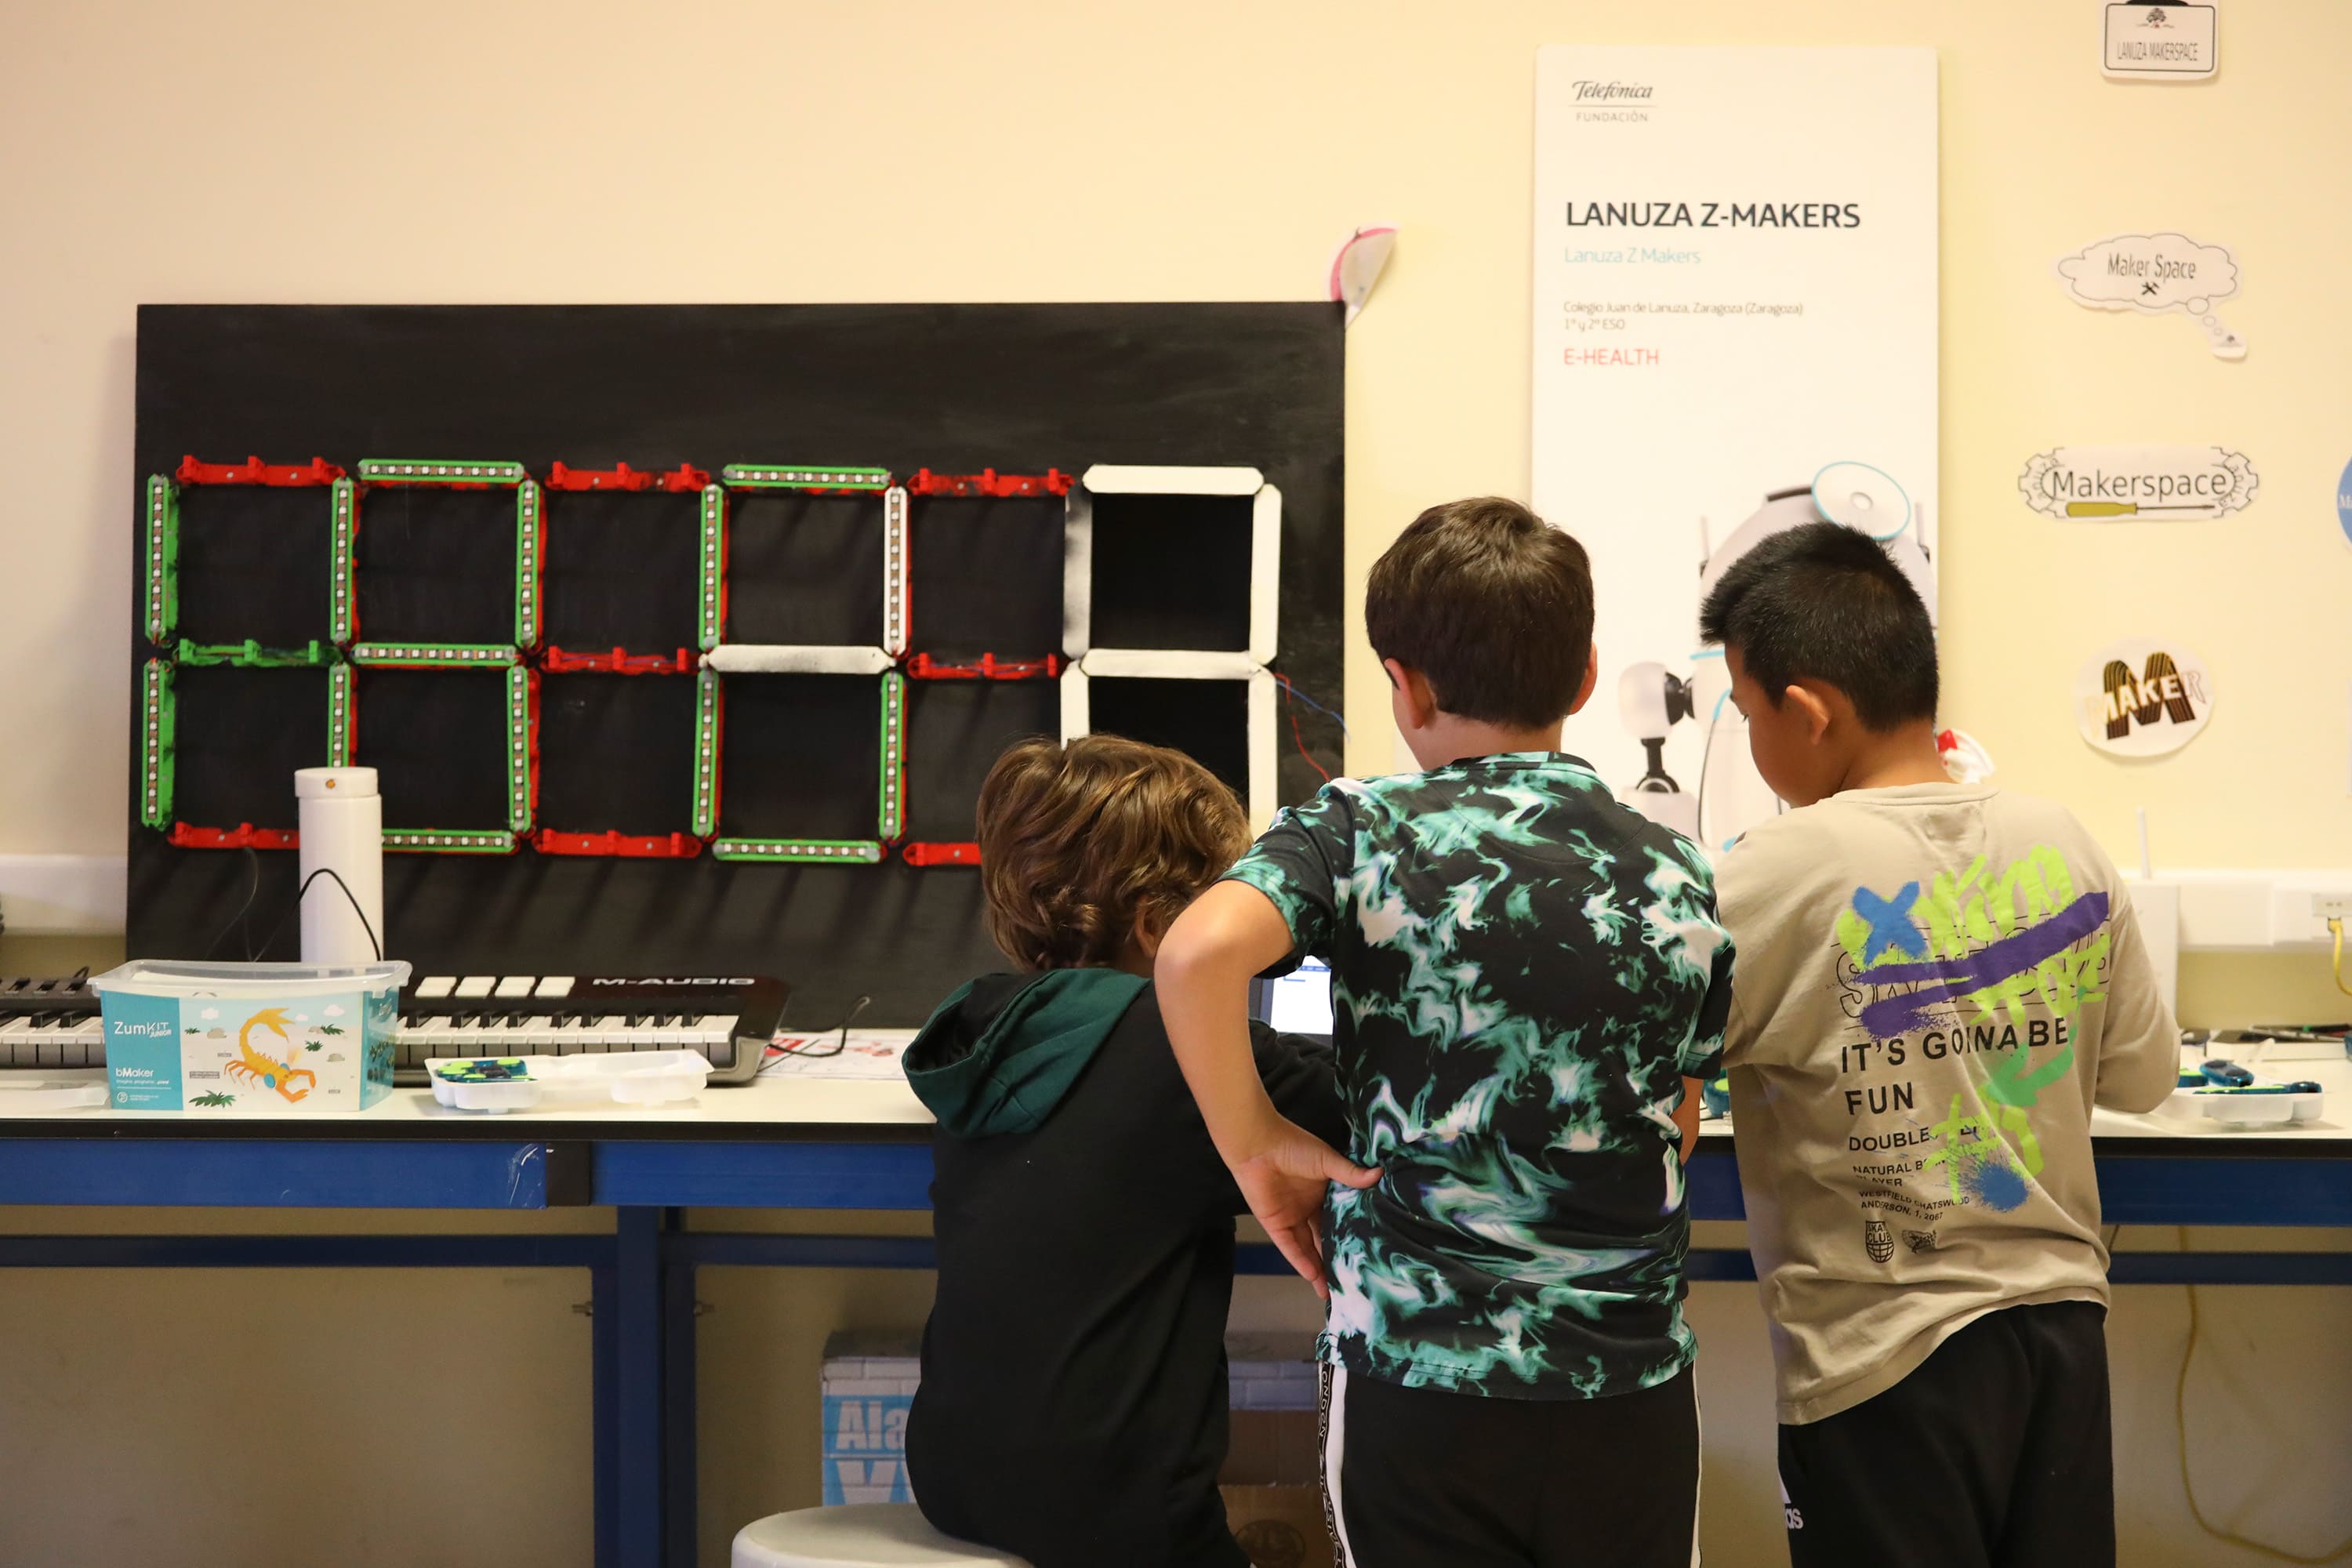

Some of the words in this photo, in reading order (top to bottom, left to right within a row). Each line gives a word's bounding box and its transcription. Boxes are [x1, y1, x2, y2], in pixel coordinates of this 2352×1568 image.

[1575, 109, 1648, 122] FUNDACIÓN
[1566, 201, 1693, 227] LANUZA
[1700, 203, 1861, 228] Z-MAKERS
[1563, 246, 1623, 263] Lanuza
[1626, 247, 1637, 263] Z
[1640, 246, 1701, 264] Makers
[2107, 252, 2150, 277] Maker
[2154, 253, 2196, 284] Space
[1563, 301, 1603, 316] Colegio
[1605, 301, 1631, 314] Juan
[1632, 301, 1647, 314] de
[1693, 303, 1743, 316] Zaragoza
[1744, 302, 1804, 318] (Zaragoza)
[1602, 319, 1625, 330] ESO
[1563, 348, 1659, 365] E-HEALTH
[2053, 469, 2227, 503] Makerspace
[1842, 1037, 1906, 1073] IT'S
[2028, 1016, 2068, 1047] BE
[115, 1067, 154, 1077] bMaker
[1845, 1081, 1914, 1115] FUN
[1849, 1127, 1930, 1152] DOUBLE
[1853, 1163, 1912, 1175] NATURAL
[1859, 1190, 1912, 1204] WESTFIELD
[1867, 1232, 1892, 1243] CLUB
[836, 1400, 909, 1450] Ala
